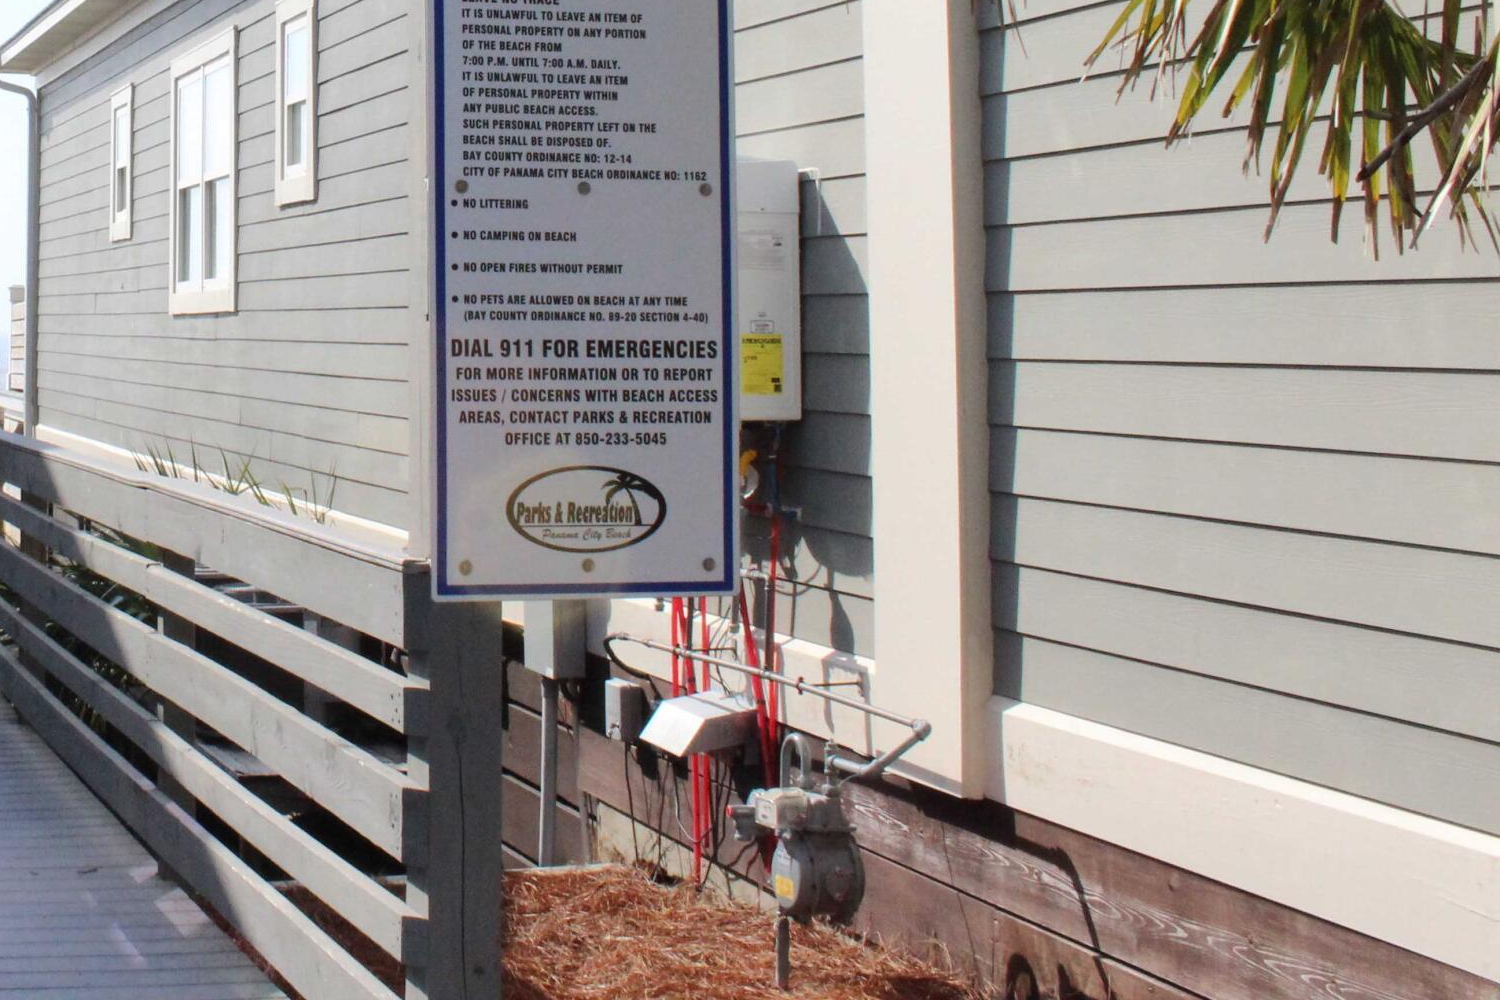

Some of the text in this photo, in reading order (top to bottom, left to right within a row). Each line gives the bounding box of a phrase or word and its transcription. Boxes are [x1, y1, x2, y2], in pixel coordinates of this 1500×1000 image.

[462, 25, 646, 39] PERSONAL PROPERTY ON ANY PORTION
[462, 41, 562, 52] OF THE BEACH FROM
[463, 199, 528, 209] NO LITTERING
[463, 231, 576, 241] NO CAMPING ON BEACH
[464, 263, 623, 274] NO OPEN FIRES WITHOUT PERMIT
[452, 339, 717, 358] DIAL 911 FOR EMERGENCIES
[456, 367, 713, 381] FOR MORE INFORMATION OR TO REPORT
[452, 390, 496, 401] ISSUES
[511, 390, 580, 402] CONCERNS
[585, 390, 617, 402] WITH
[623, 390, 664, 402] BEACH
[670, 390, 717, 402] ACCESS
[459, 411, 711, 425] AREAS, CONTACT PARKS & RECREATION
[505, 433, 666, 445] OFFICE AT 850-233-5045
[516, 502, 633, 524] Parks & Recreation
[542, 528, 631, 541] Panama City Beach
